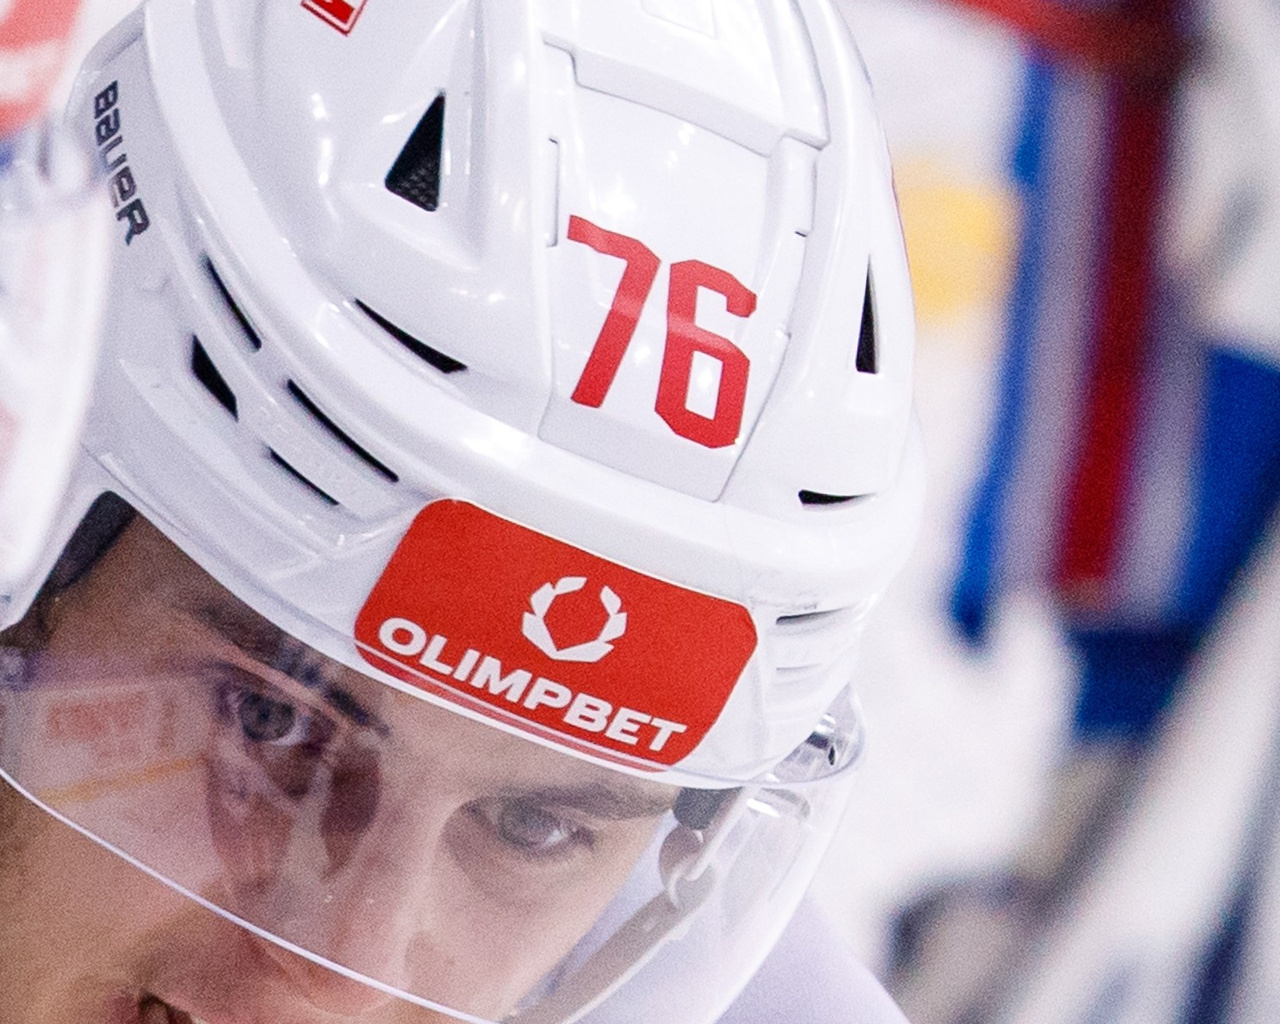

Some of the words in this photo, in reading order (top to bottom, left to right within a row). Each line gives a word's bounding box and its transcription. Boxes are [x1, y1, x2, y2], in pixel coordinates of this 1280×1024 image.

[93, 80, 150, 246] BAUER
[567, 214, 757, 449] 76
[378, 617, 687, 752] OLIMPBET
